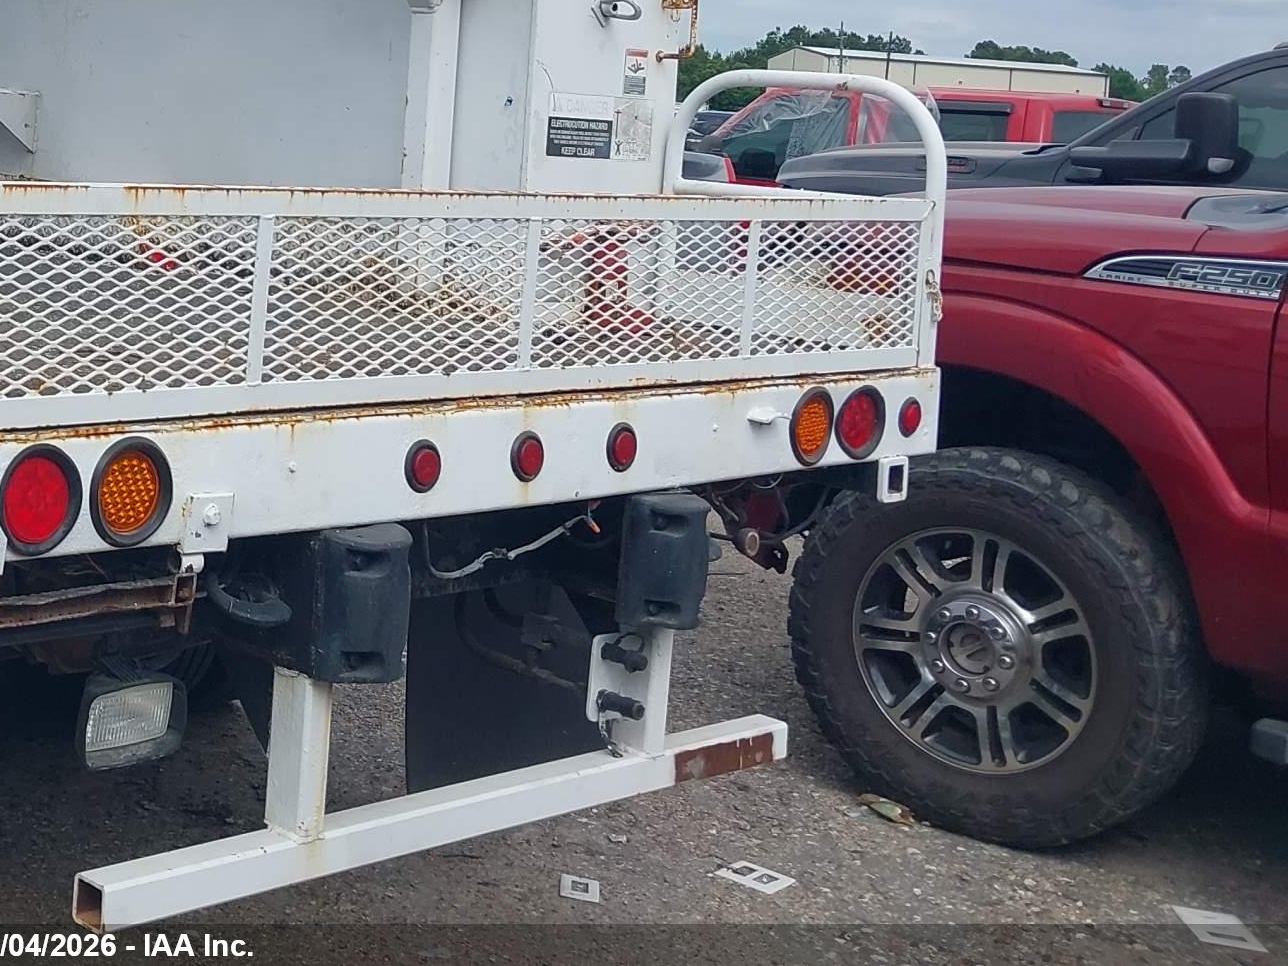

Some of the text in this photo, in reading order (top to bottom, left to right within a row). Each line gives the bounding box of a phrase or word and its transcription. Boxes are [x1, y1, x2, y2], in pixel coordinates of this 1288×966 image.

[560, 146, 595, 156] KEEP CLEAR
[1167, 263, 1283, 290] F-250
[1168, 281, 1274, 298] SUPER DUTY
